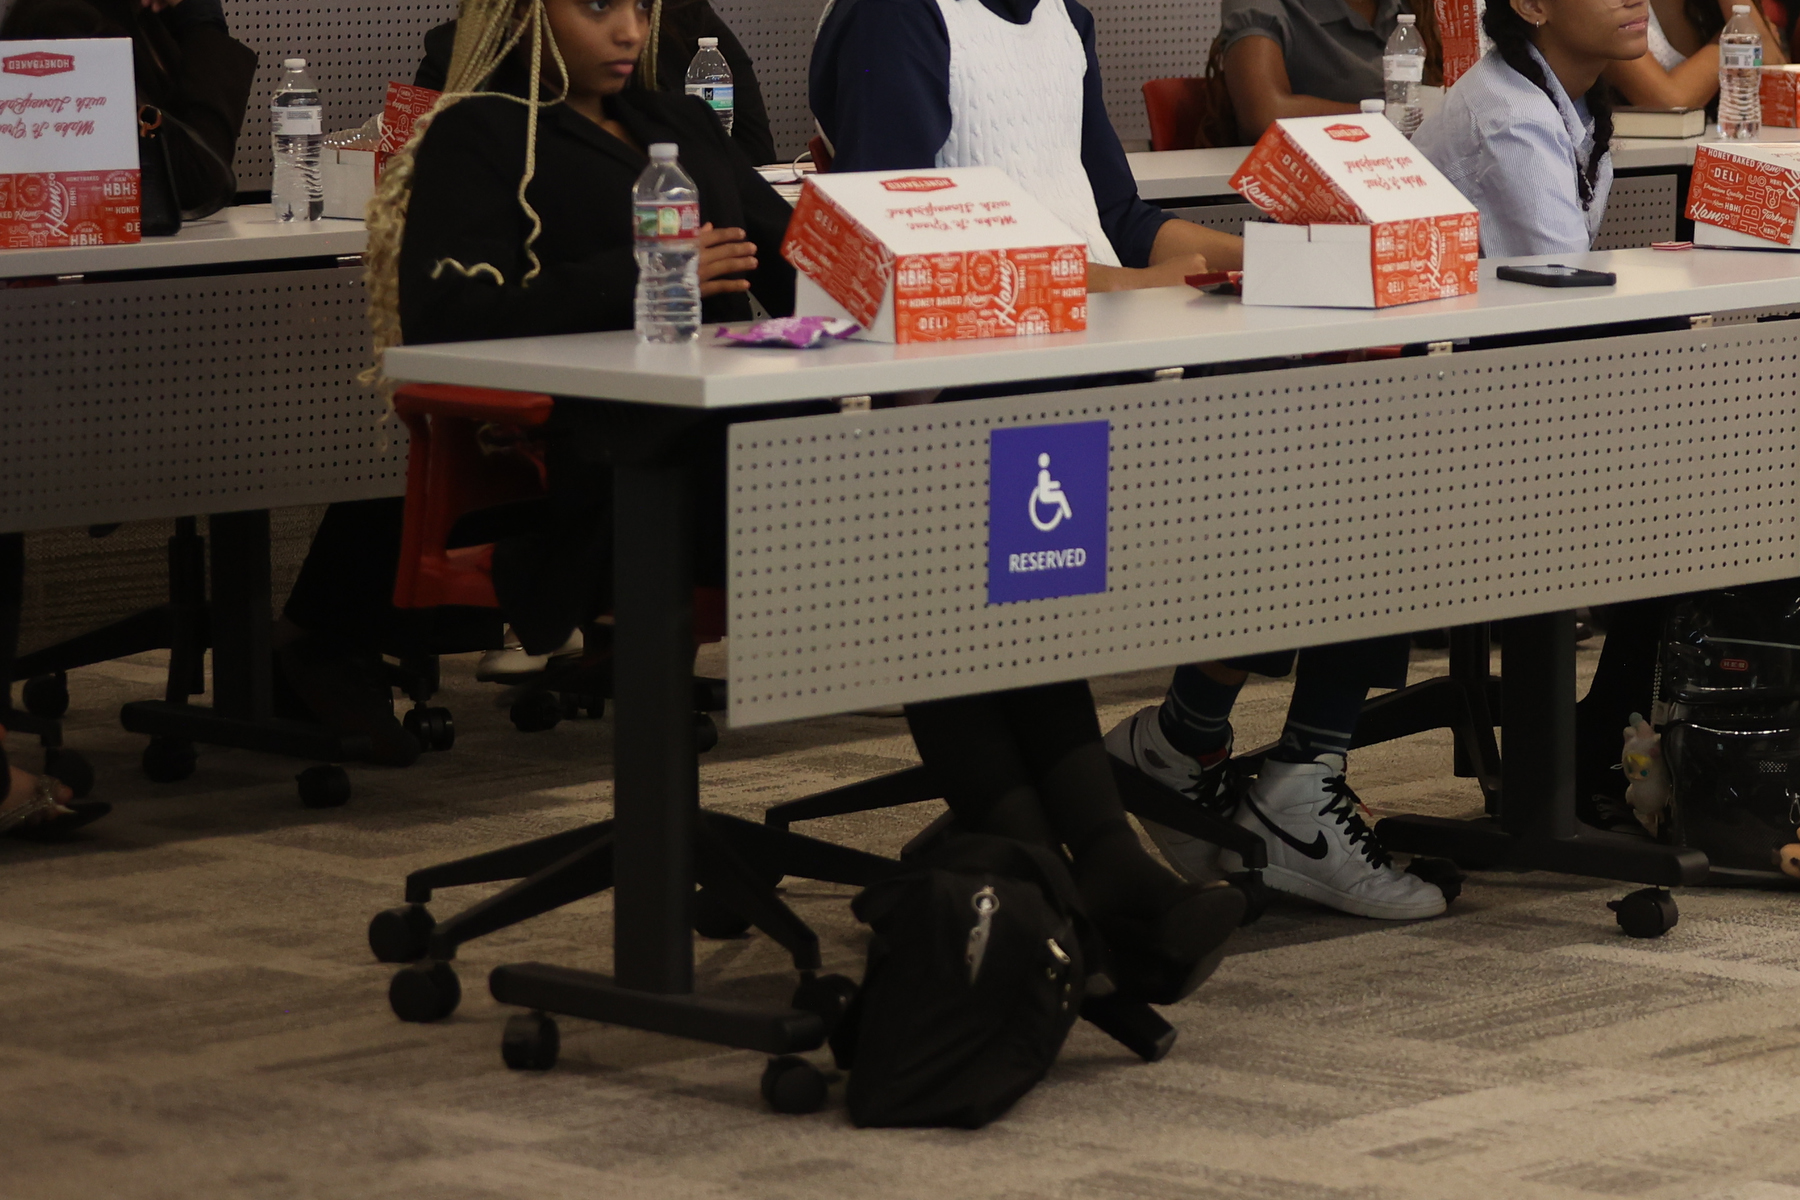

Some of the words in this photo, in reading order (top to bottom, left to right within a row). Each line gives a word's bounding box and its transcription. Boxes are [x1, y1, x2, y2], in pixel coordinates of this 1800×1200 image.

[8, 59, 70, 70] HONEYBAKED
[54, 120, 95, 138] Make
[1708, 148, 1731, 161] HONEY
[1732, 154, 1756, 168] BAKED
[1281, 153, 1310, 183] DELI
[1714, 167, 1740, 183] DELI
[0, 210, 12, 219] KED
[115, 206, 140, 214] HONEY
[125, 221, 140, 232] DE
[909, 297, 935, 308] HONEY
[1070, 305, 1087, 319] DE
[917, 316, 949, 331] DELI
[1009, 548, 1086, 573] RESERVED
